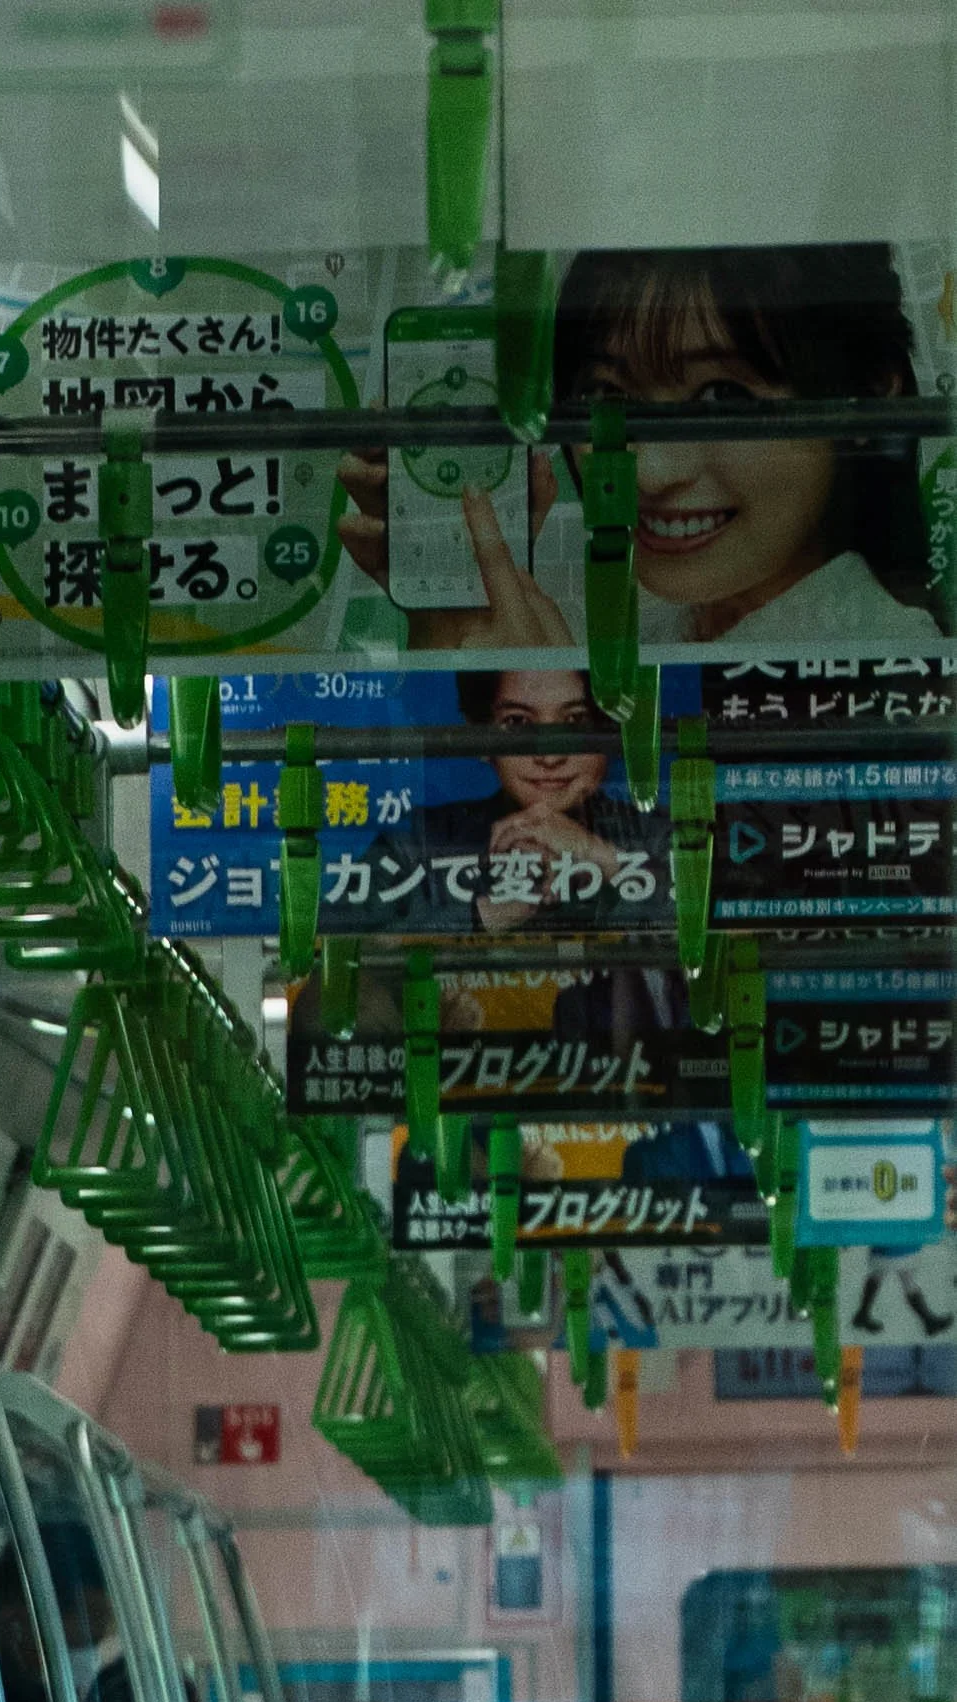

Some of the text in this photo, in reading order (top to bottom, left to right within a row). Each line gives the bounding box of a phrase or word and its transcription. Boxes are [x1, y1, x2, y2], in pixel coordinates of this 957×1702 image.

[295, 300, 327, 322] 16
[44, 314, 281, 359] 物件たくさん!
[44, 458, 282, 523] まっと!
[0, 506, 30, 528] 10
[274, 542, 309, 563] 25
[220, 676, 258, 702] o.1
[315, 672, 385, 700] 30万社
[173, 781, 412, 830] 計務が
[439, 1039, 651, 1094] プログリット
[522, 1186, 708, 1234] プログリット
